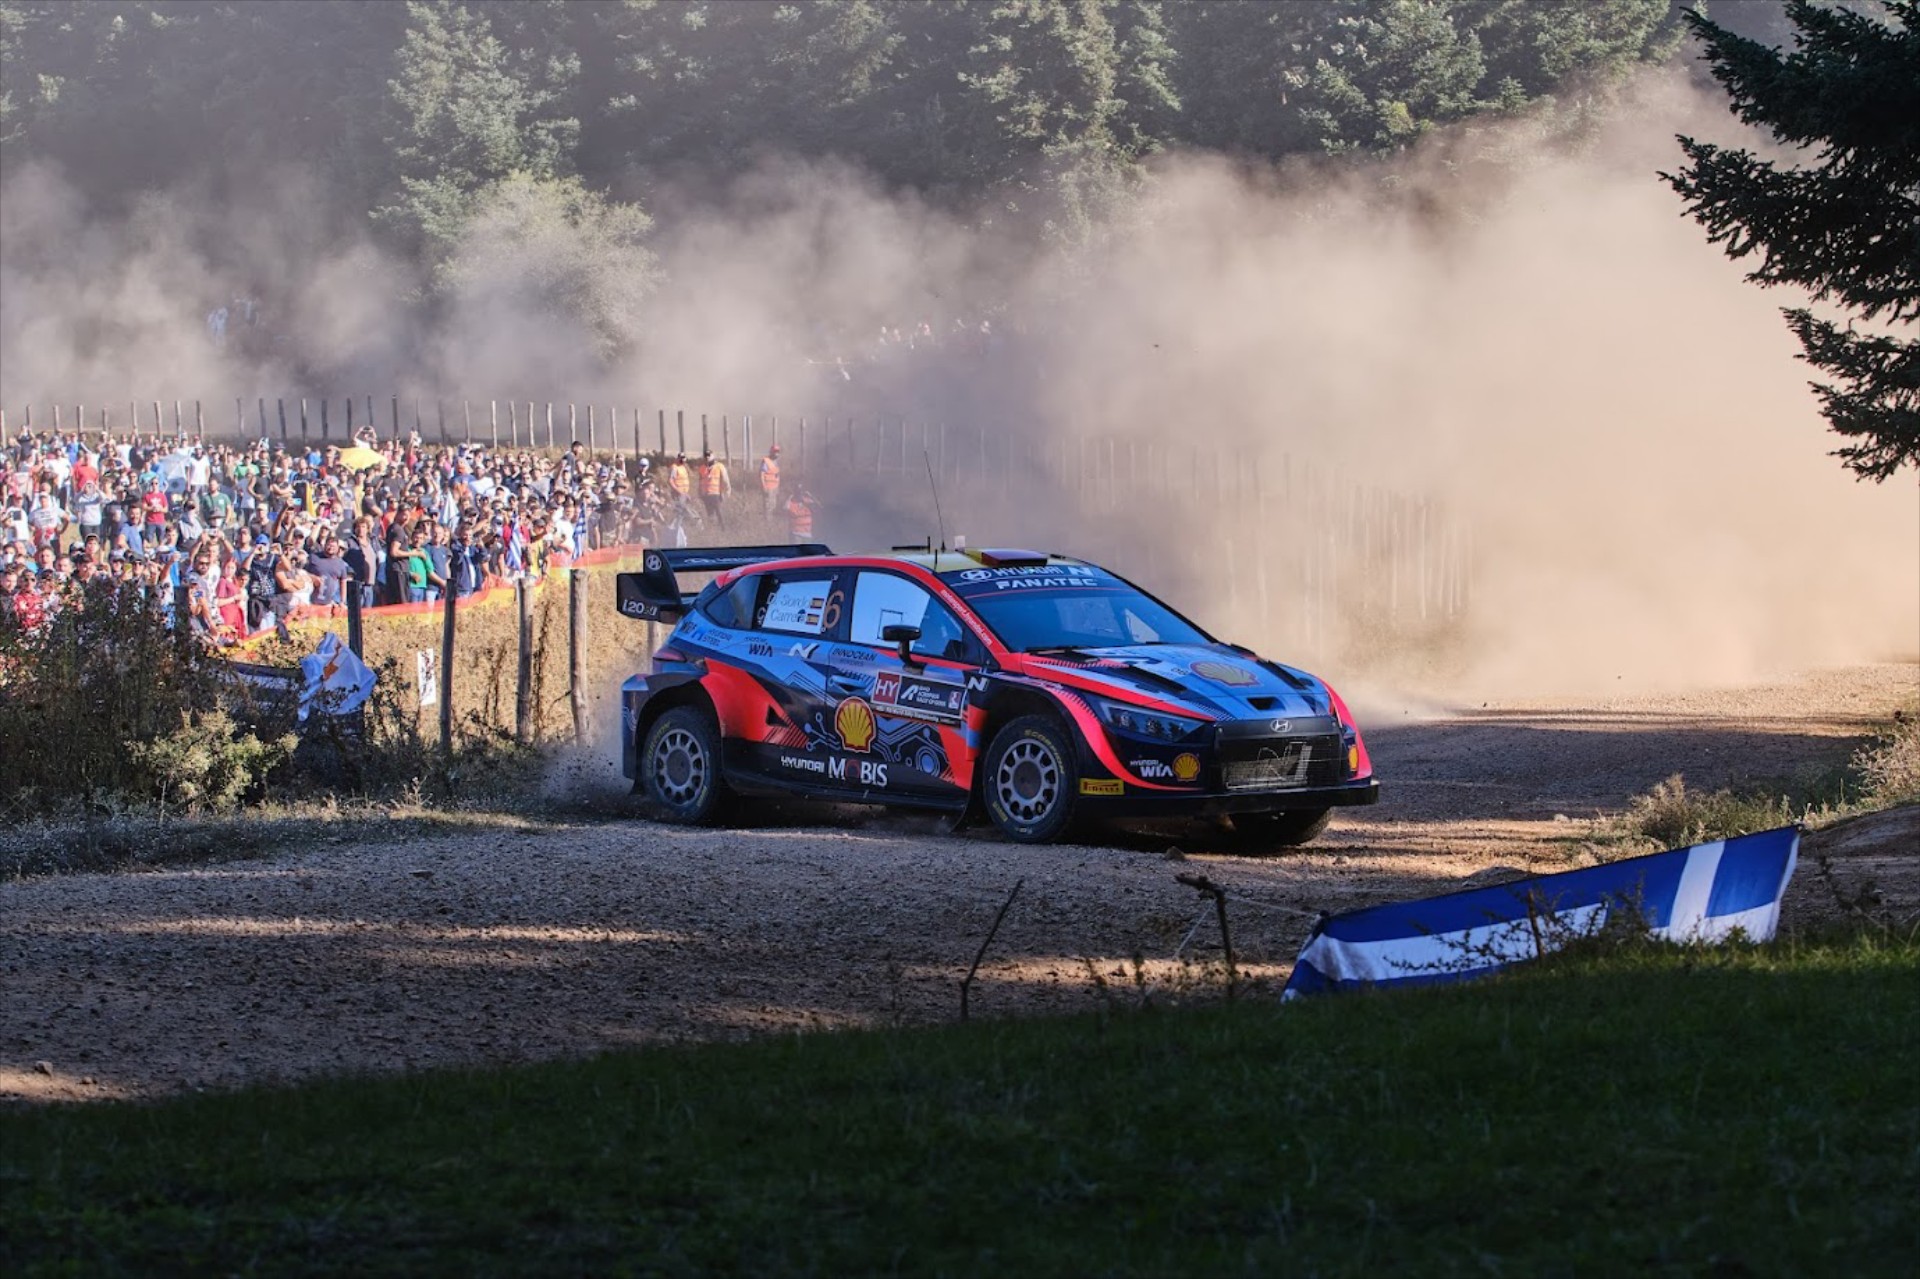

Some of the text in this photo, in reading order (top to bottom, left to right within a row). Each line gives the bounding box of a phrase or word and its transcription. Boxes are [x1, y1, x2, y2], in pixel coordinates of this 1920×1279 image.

[995, 578, 1098, 590] FANATEC
[823, 590, 845, 629] 6
[748, 642, 773, 658] WIA
[875, 678, 898, 698] HY
[1129, 759, 1159, 767] HYUNDAI
[780, 755, 888, 787] HYUNDAI MOBIS
[1140, 764, 1174, 778] WIA
[1083, 780, 1120, 793] PIRELLI
